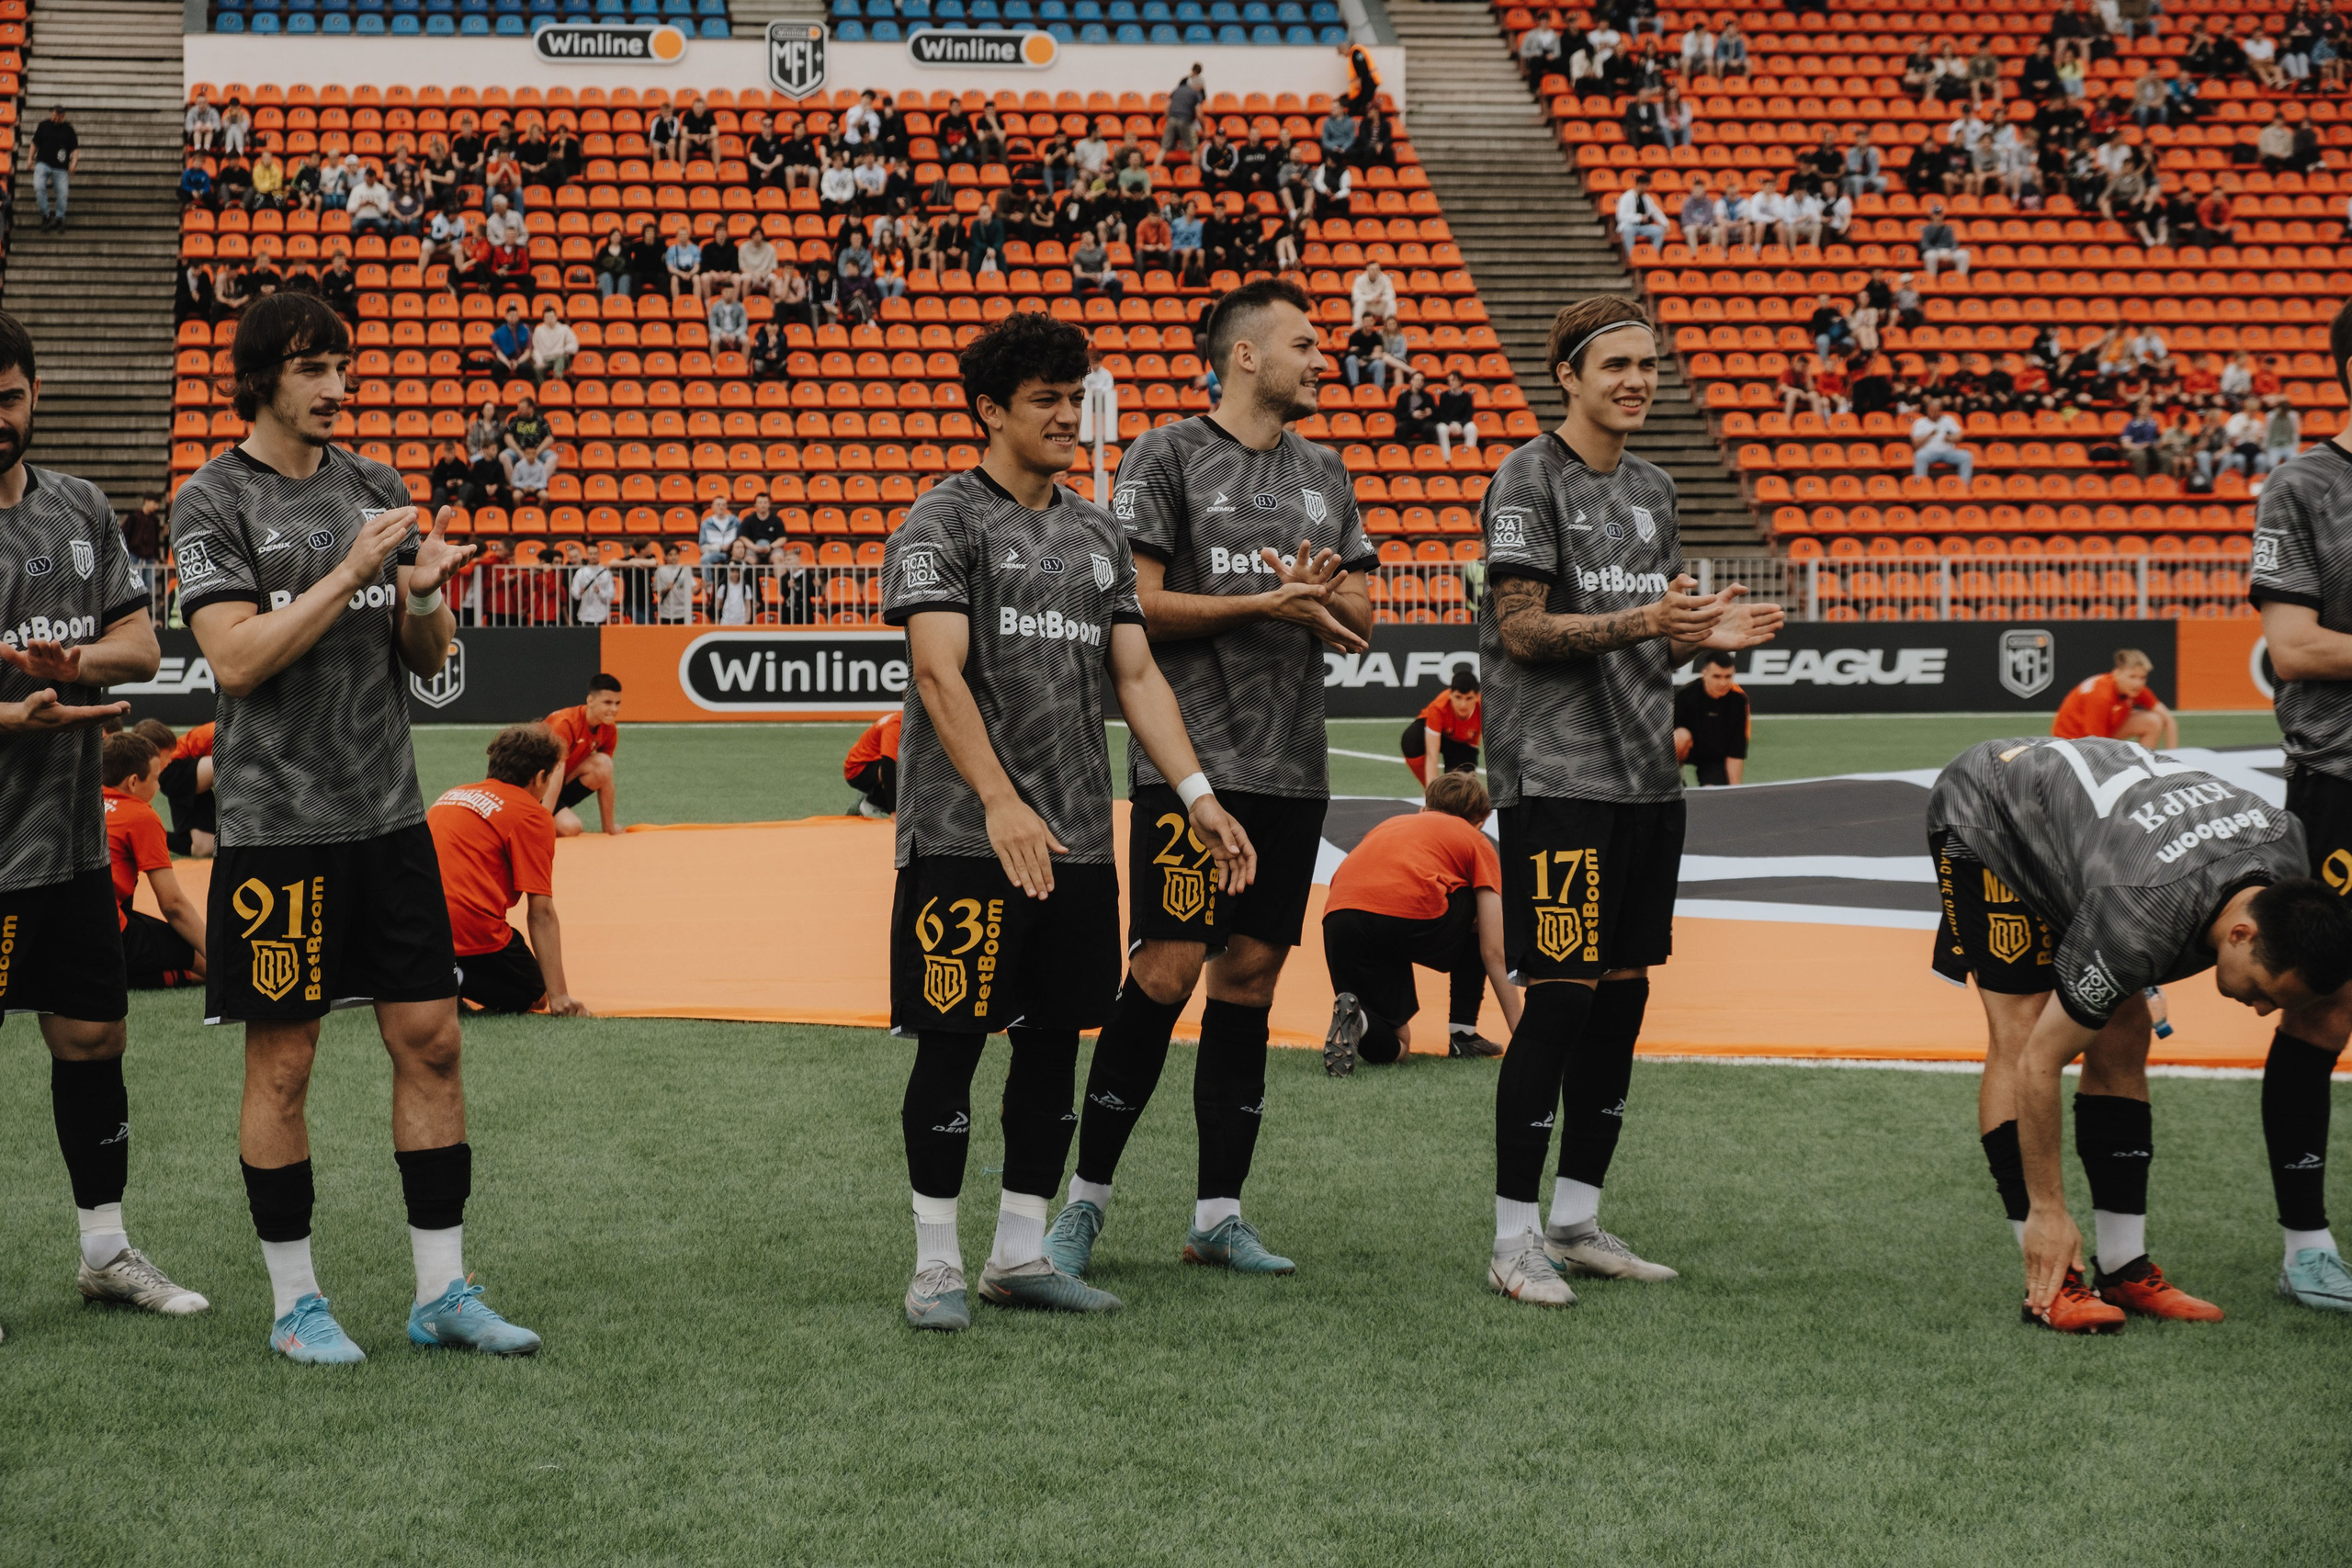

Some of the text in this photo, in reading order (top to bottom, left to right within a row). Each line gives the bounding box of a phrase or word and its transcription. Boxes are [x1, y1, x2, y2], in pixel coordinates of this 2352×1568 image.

[546, 31, 644, 56] Winline
[920, 37, 1017, 62] Winline
[258, 541, 291, 554] DEMIX
[2, 615, 96, 649] etBoom
[1000, 606, 1102, 647] BetBoom
[708, 650, 909, 693] Winline
[1323, 651, 1401, 688] DIA
[2129, 782, 2237, 834] КИРЯ
[2155, 808, 2271, 863] BetBoom
[1204, 859, 1220, 926] BetB
[1529, 849, 1585, 905] 17
[232, 877, 307, 940] 91
[915, 896, 984, 955] 63
[1582, 848, 1600, 962] BetBoom
[304, 875, 324, 1001] BetBoom
[974, 898, 1004, 1017] BetBoom
